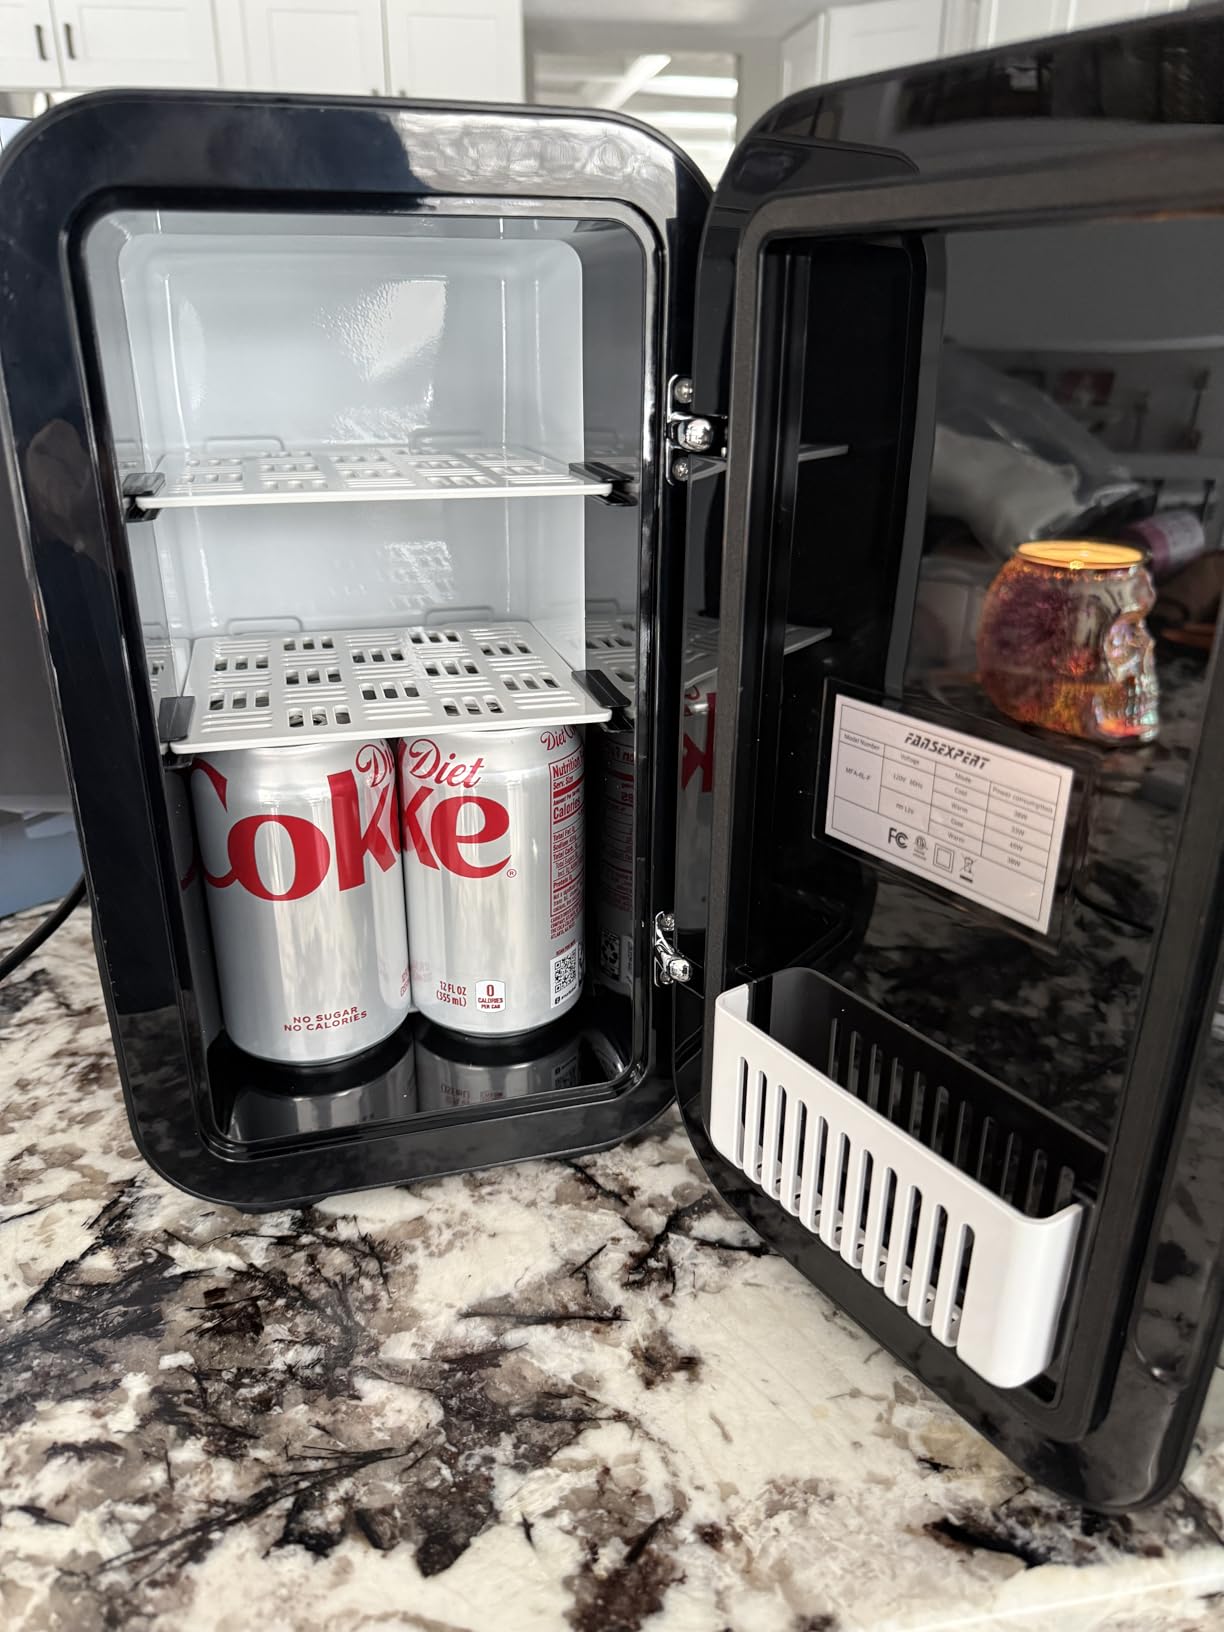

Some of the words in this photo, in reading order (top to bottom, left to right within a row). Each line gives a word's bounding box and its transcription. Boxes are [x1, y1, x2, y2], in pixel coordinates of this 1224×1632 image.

[860, 738, 880, 751] Number
[904, 732, 991, 770] FANSEXPERT
[409, 738, 485, 788] Diet
[440, 980, 447, 991] 12
[447, 983, 456, 995] FL
[456, 985, 467, 996] OZ
[486, 984, 495, 997] 0
[436, 990, 450, 1005] (355
[284, 1024, 302, 1032] NO
[306, 1010, 367, 1031] CALORIES
[293, 1016, 311, 1024] NO
[315, 1006, 358, 1022] SUGAR
